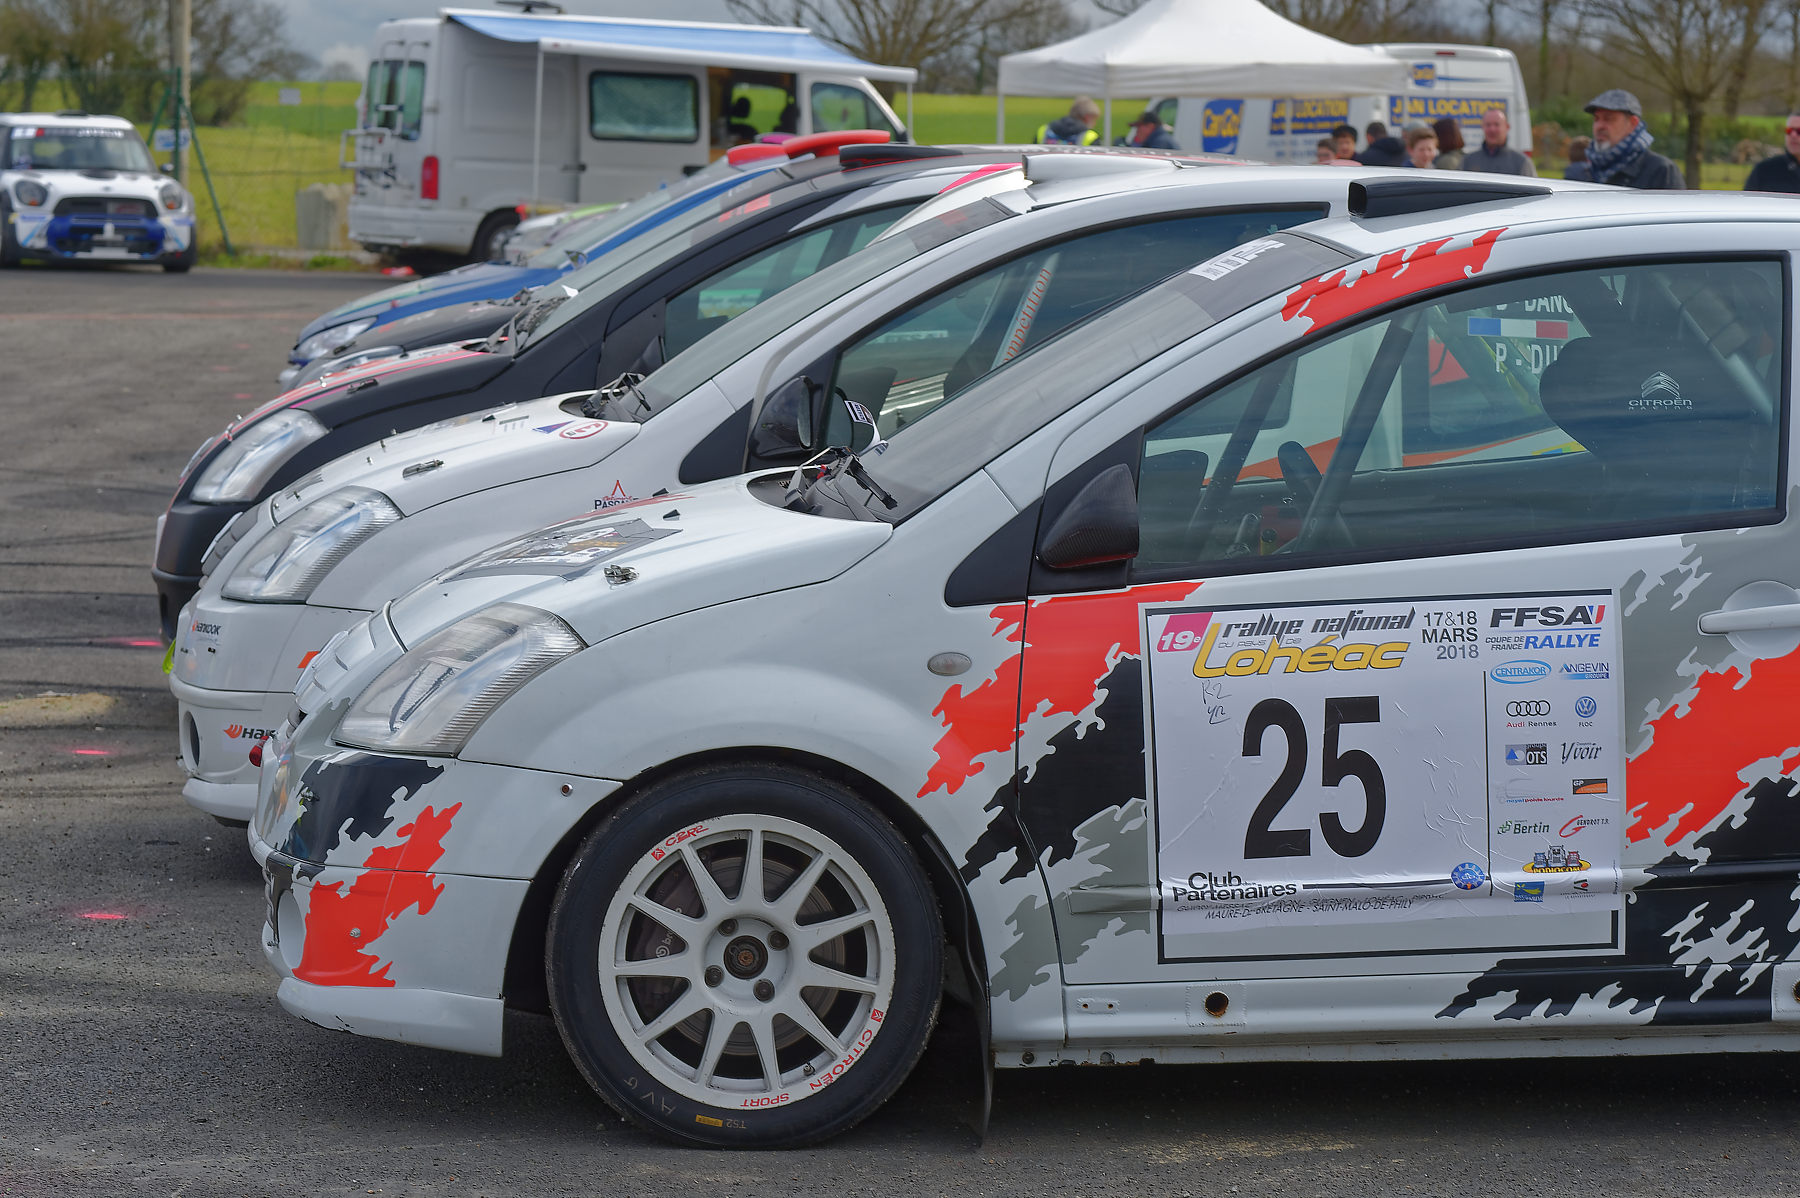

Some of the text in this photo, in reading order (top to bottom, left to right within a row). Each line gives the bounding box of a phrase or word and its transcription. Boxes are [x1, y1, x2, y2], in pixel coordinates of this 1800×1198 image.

[1531, 344, 1564, 374] DU
[1222, 606, 1416, 641] rallye national
[1422, 610, 1477, 626] 17&18
[1490, 605, 1593, 628] FFSA
[1422, 627, 1478, 643] MARS
[1524, 634, 1601, 649] RALLYE
[1193, 623, 1410, 678] Lohéac
[1436, 645, 1479, 660] 2018
[1495, 666, 1547, 677] CENTRAKOR
[1526, 751, 1547, 764] OTS
[1242, 696, 1387, 859] 25
[1514, 822, 1549, 834] Bertin
[1188, 872, 1242, 890] Club
[1172, 883, 1297, 902] Partenaires
[740, 1093, 790, 1107] SPORT
